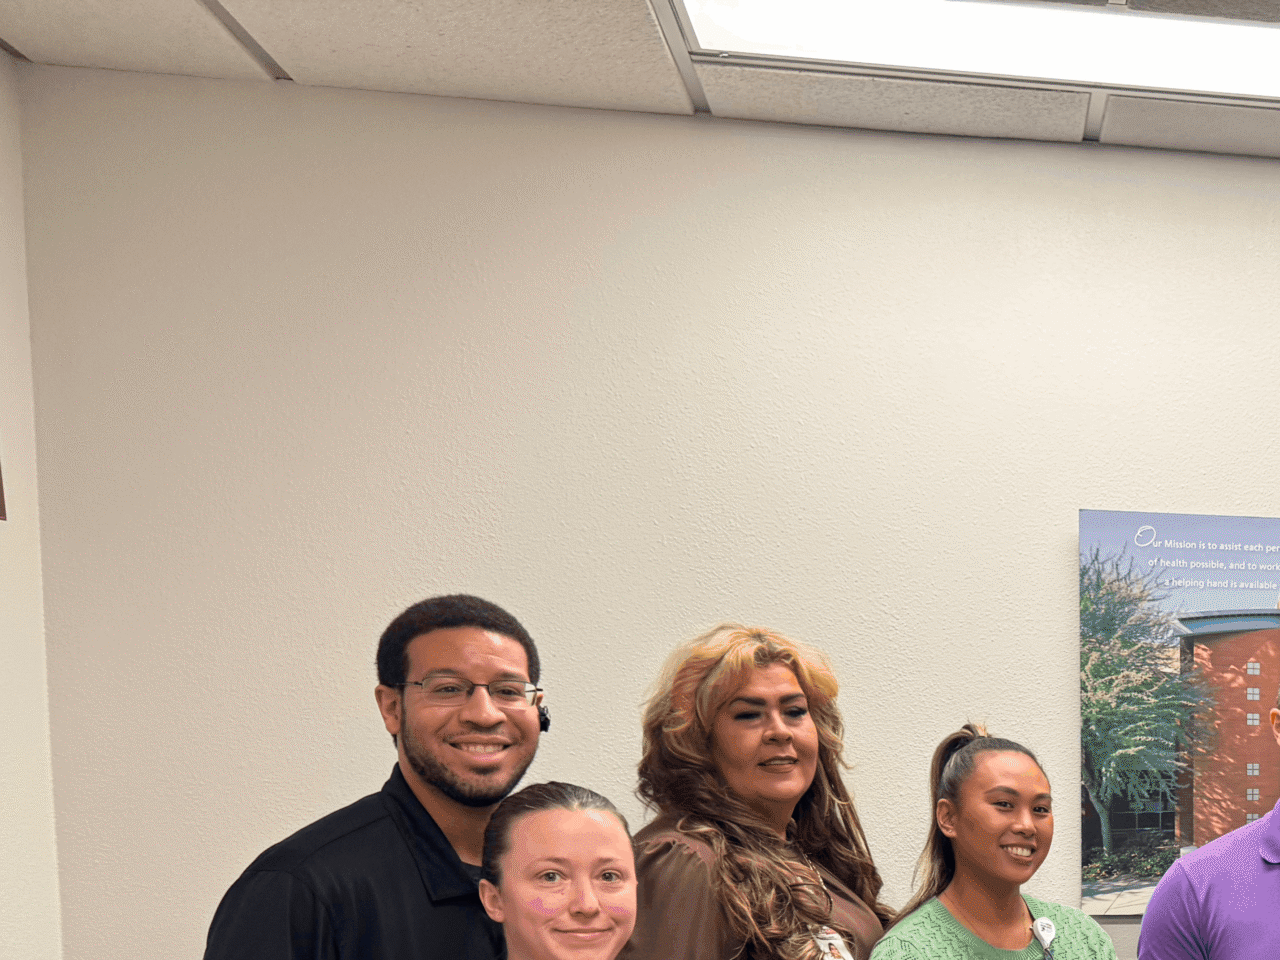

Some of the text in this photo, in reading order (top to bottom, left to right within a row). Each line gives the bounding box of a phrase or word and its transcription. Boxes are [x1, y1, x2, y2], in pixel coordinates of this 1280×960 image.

[1134, 525, 1162, 548] Our
[1164, 539, 1196, 549] Mission
[1198, 541, 1206, 550] is
[1207, 541, 1218, 550] to
[1219, 542, 1242, 551] assist
[1243, 542, 1264, 552] each
[1147, 558, 1158, 567] of
[1159, 558, 1188, 568] health
[1190, 559, 1227, 570] possible,
[1228, 561, 1246, 570] and
[1247, 562, 1257, 570] to
[1259, 562, 1280, 571] work
[1171, 578, 1205, 589] helping
[1206, 578, 1229, 588] hand
[1230, 579, 1238, 588] is
[1239, 580, 1278, 590] available
